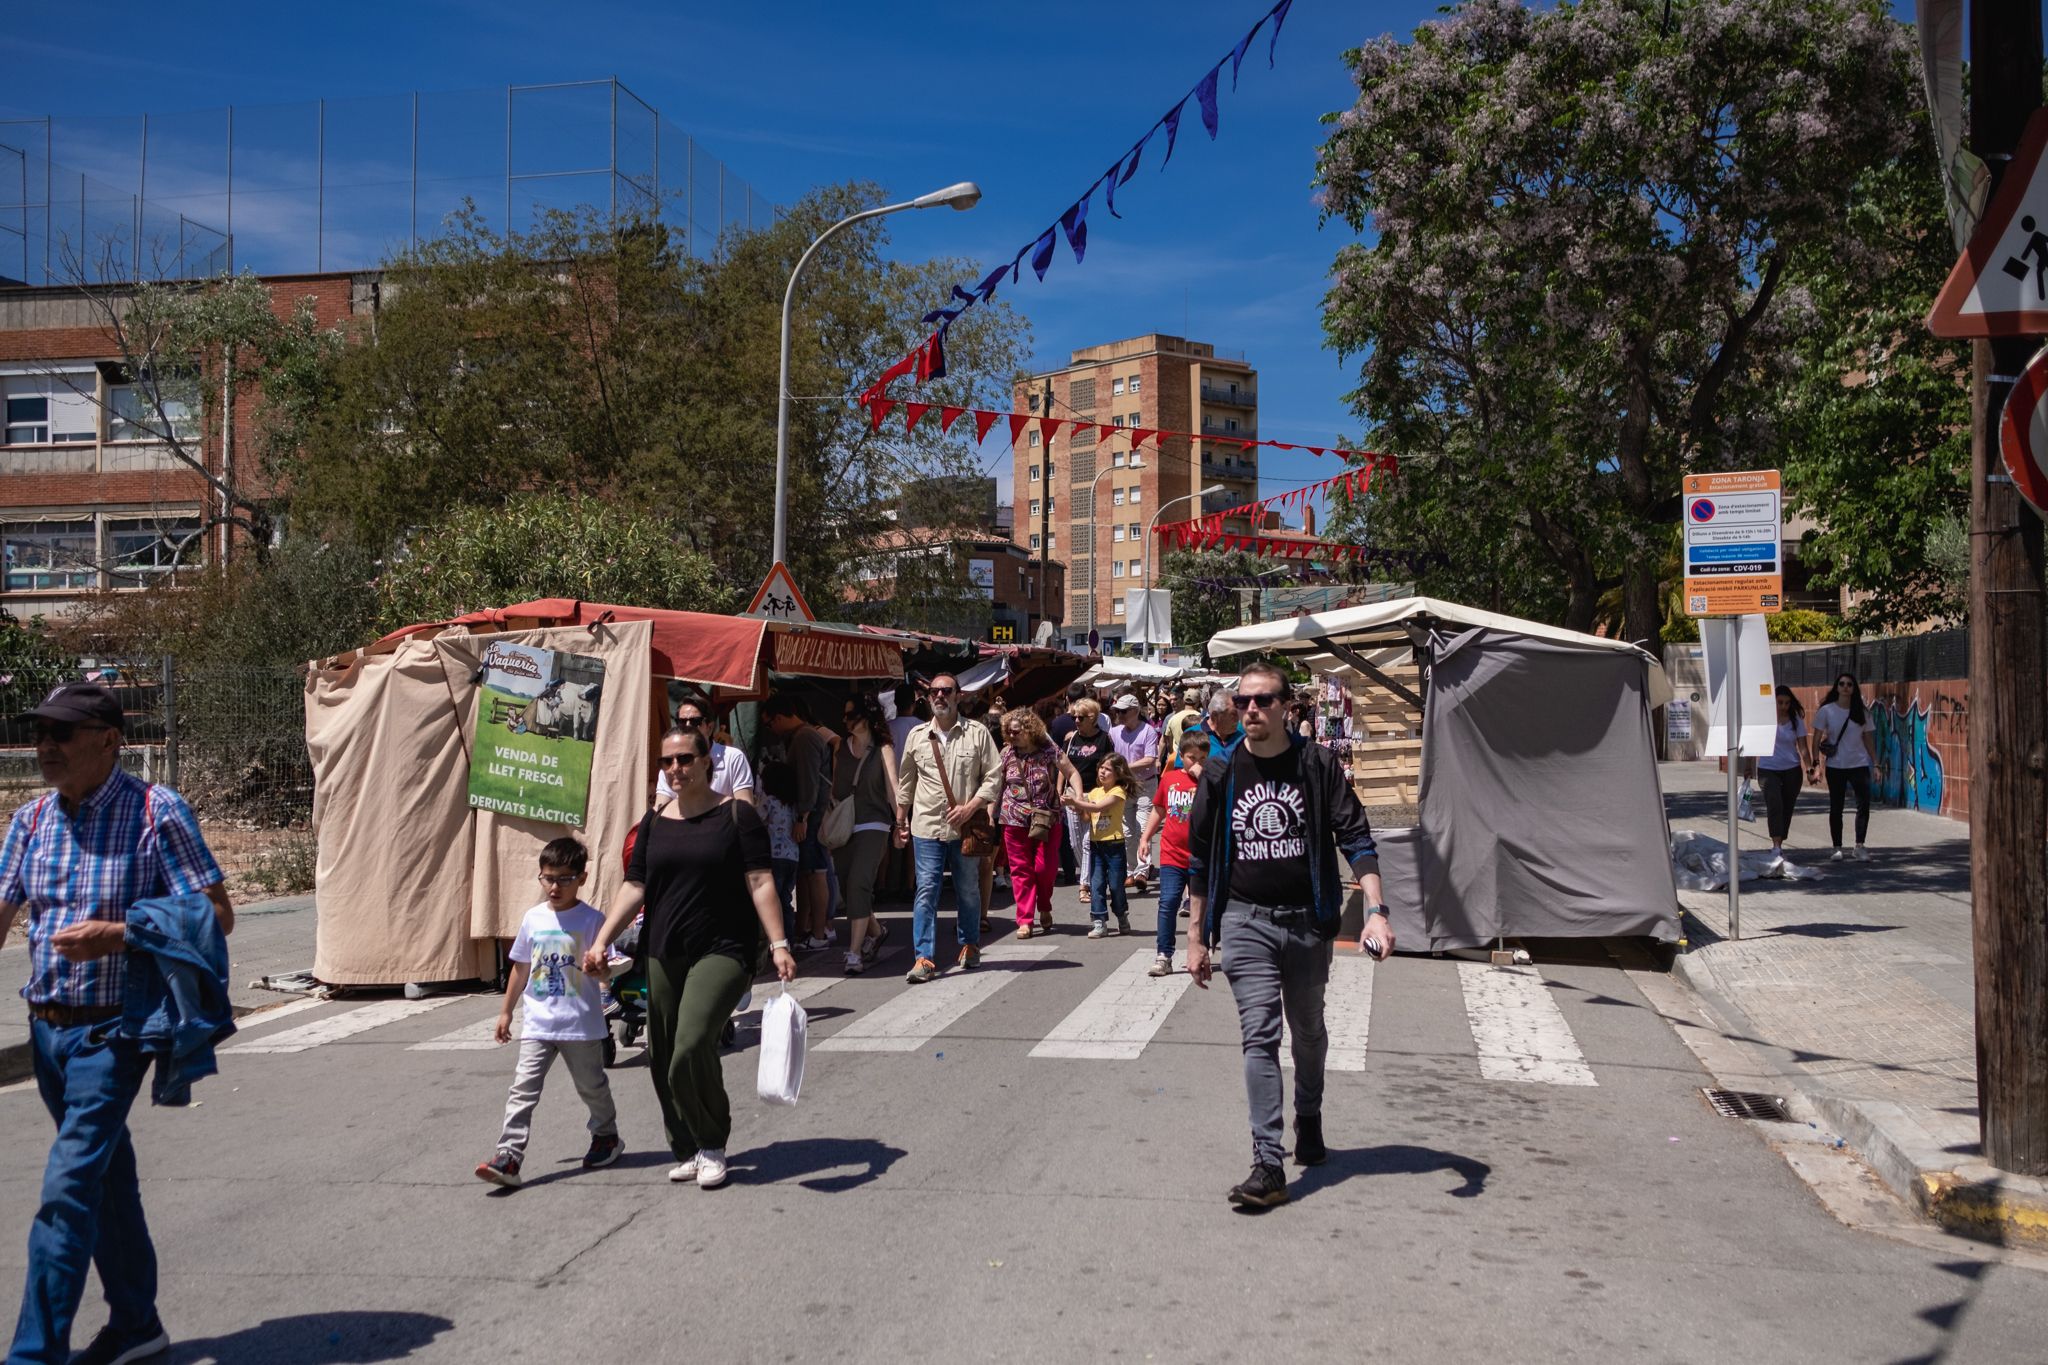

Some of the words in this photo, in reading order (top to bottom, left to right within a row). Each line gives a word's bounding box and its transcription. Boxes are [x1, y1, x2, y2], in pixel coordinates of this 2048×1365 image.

[1734, 474, 1764, 482] TARONJA
[993, 626, 1013, 640] FH
[488, 644, 499, 654] La
[489, 654, 538, 674] Vaqueria
[495, 746, 537, 764] VENDA
[541, 755, 558, 768] DE
[488, 762, 515, 778] LLET
[518, 768, 564, 787] FRESCA
[519, 786, 524, 797] i
[470, 794, 526, 815] DERIVATS
[530, 804, 580, 825] LÀCTICS
[1232, 781, 1276, 831] DRAGON
[1244, 840, 1268, 860] SON
[1270, 838, 1304, 859] GOKU
